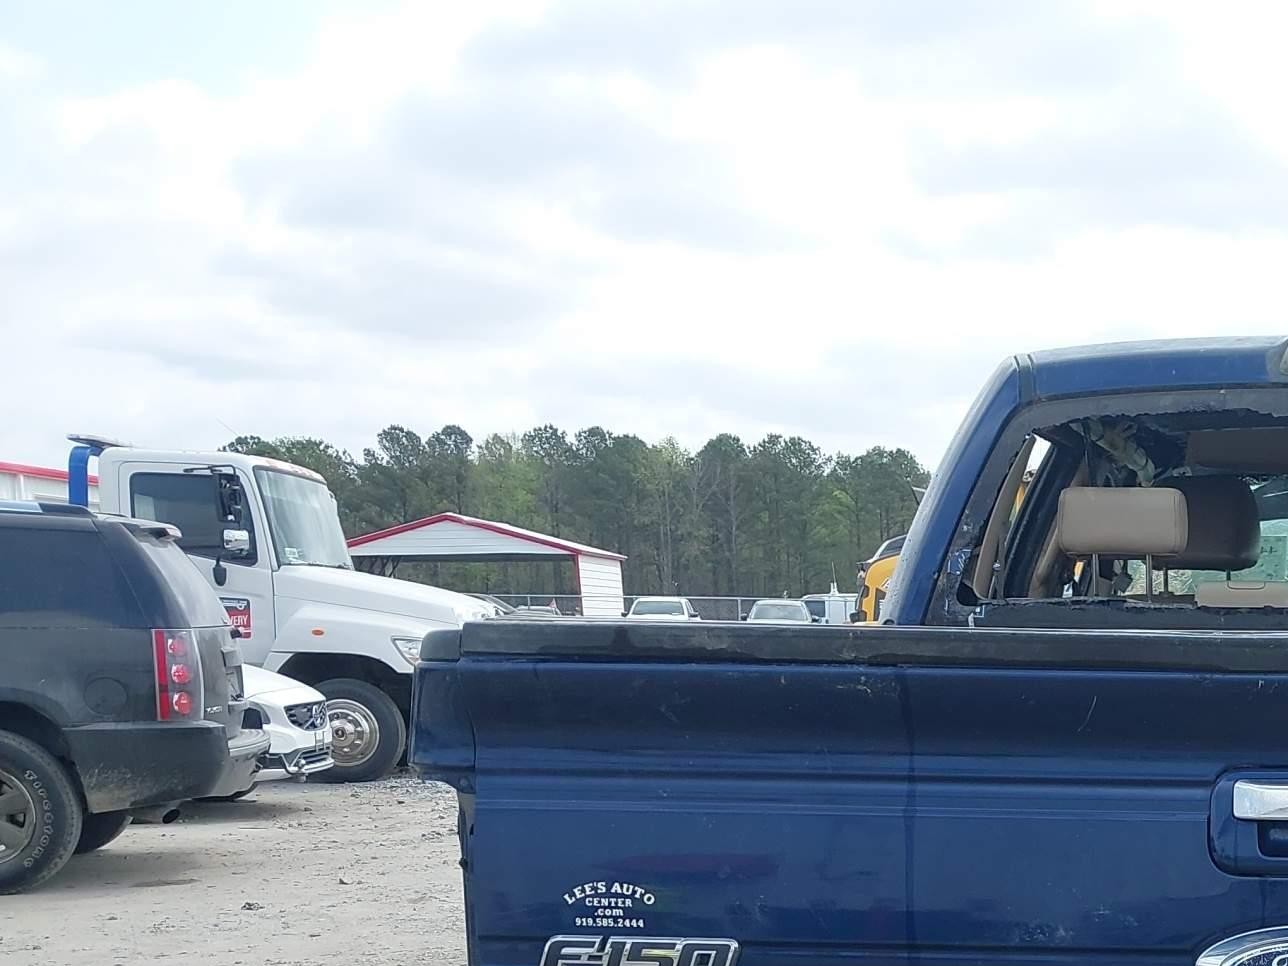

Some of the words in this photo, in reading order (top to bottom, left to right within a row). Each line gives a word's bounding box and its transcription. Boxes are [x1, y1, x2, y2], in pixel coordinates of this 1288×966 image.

[229, 614, 249, 625] VERY
[563, 881, 606, 904] LEE'S
[611, 882, 655, 904] AUTO
[585, 897, 632, 907] CENTER
[594, 908, 624, 917] .com
[575, 917, 645, 928] 919.585.2444
